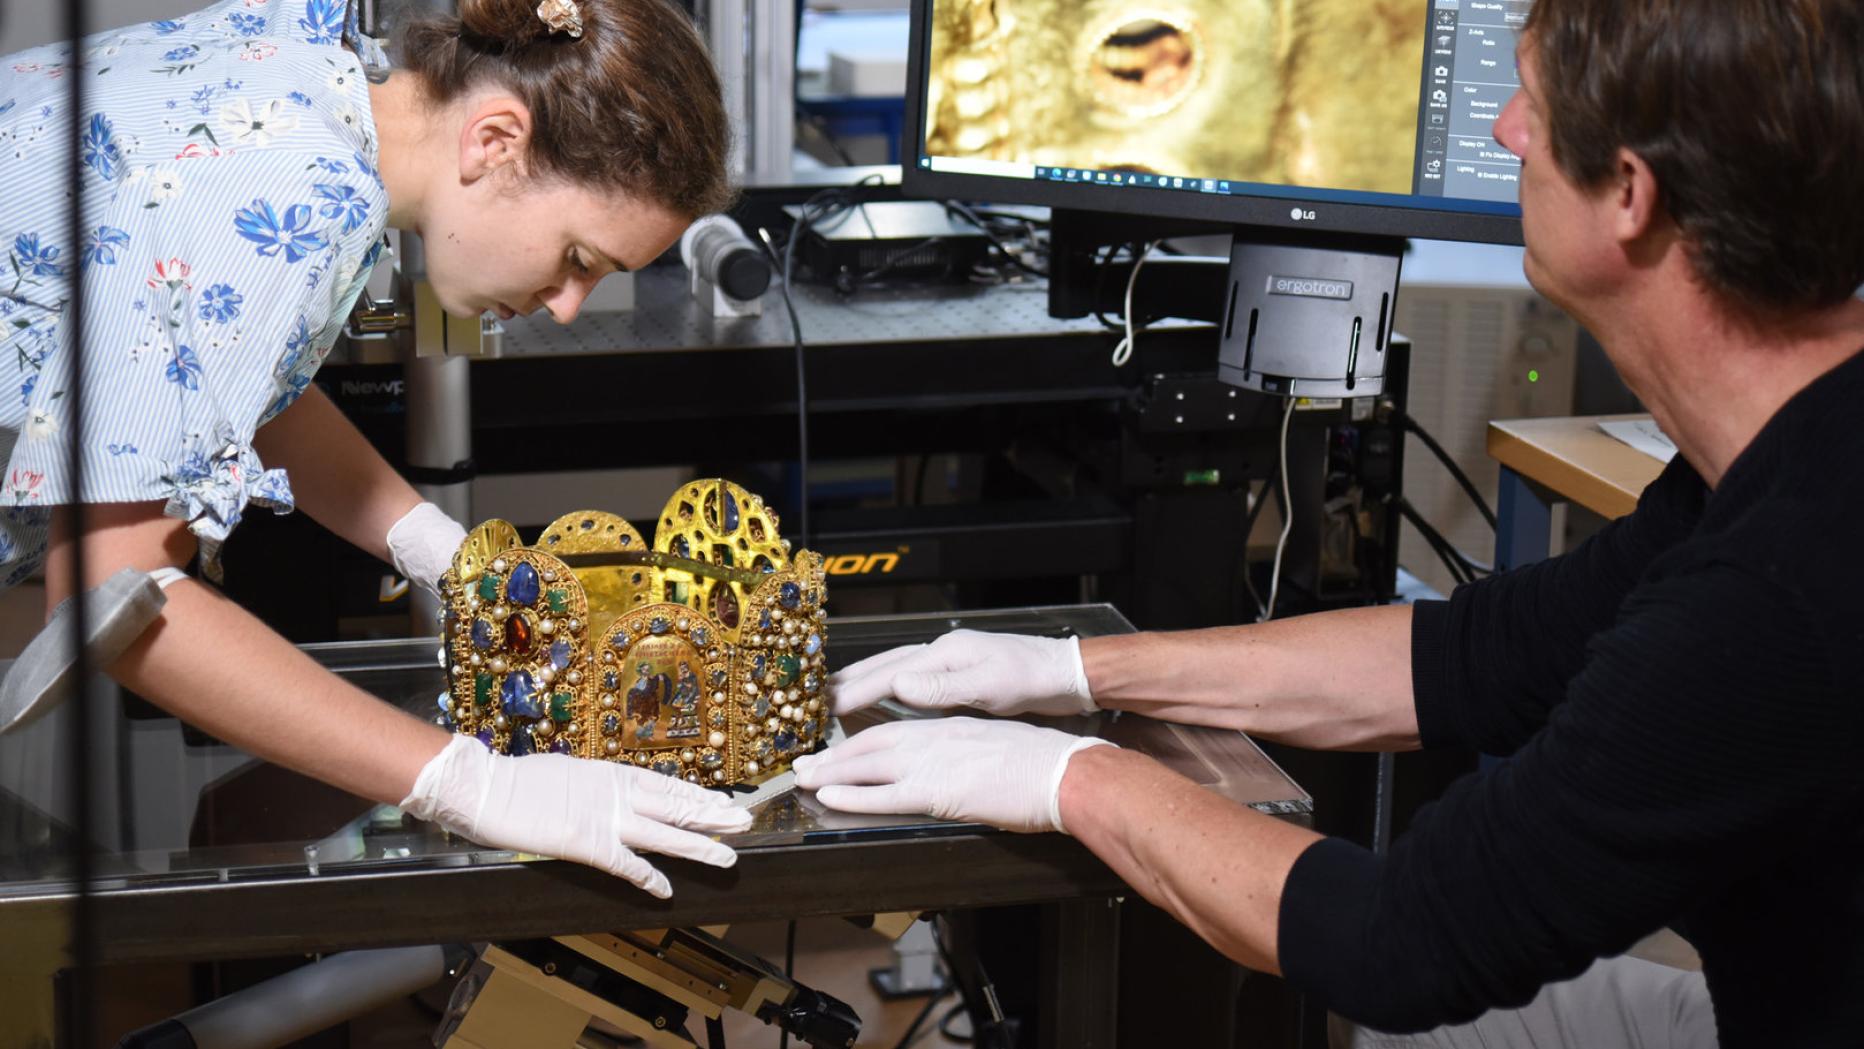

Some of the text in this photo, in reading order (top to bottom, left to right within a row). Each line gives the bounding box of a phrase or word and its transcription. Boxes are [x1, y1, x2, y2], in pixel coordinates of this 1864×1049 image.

[1458, 140, 1476, 148] Display
[1456, 165, 1475, 173] Lighting
[1499, 173, 1518, 182] Lighting
[1276, 279, 1346, 296] ergotron
[341, 380, 405, 396] Newp
